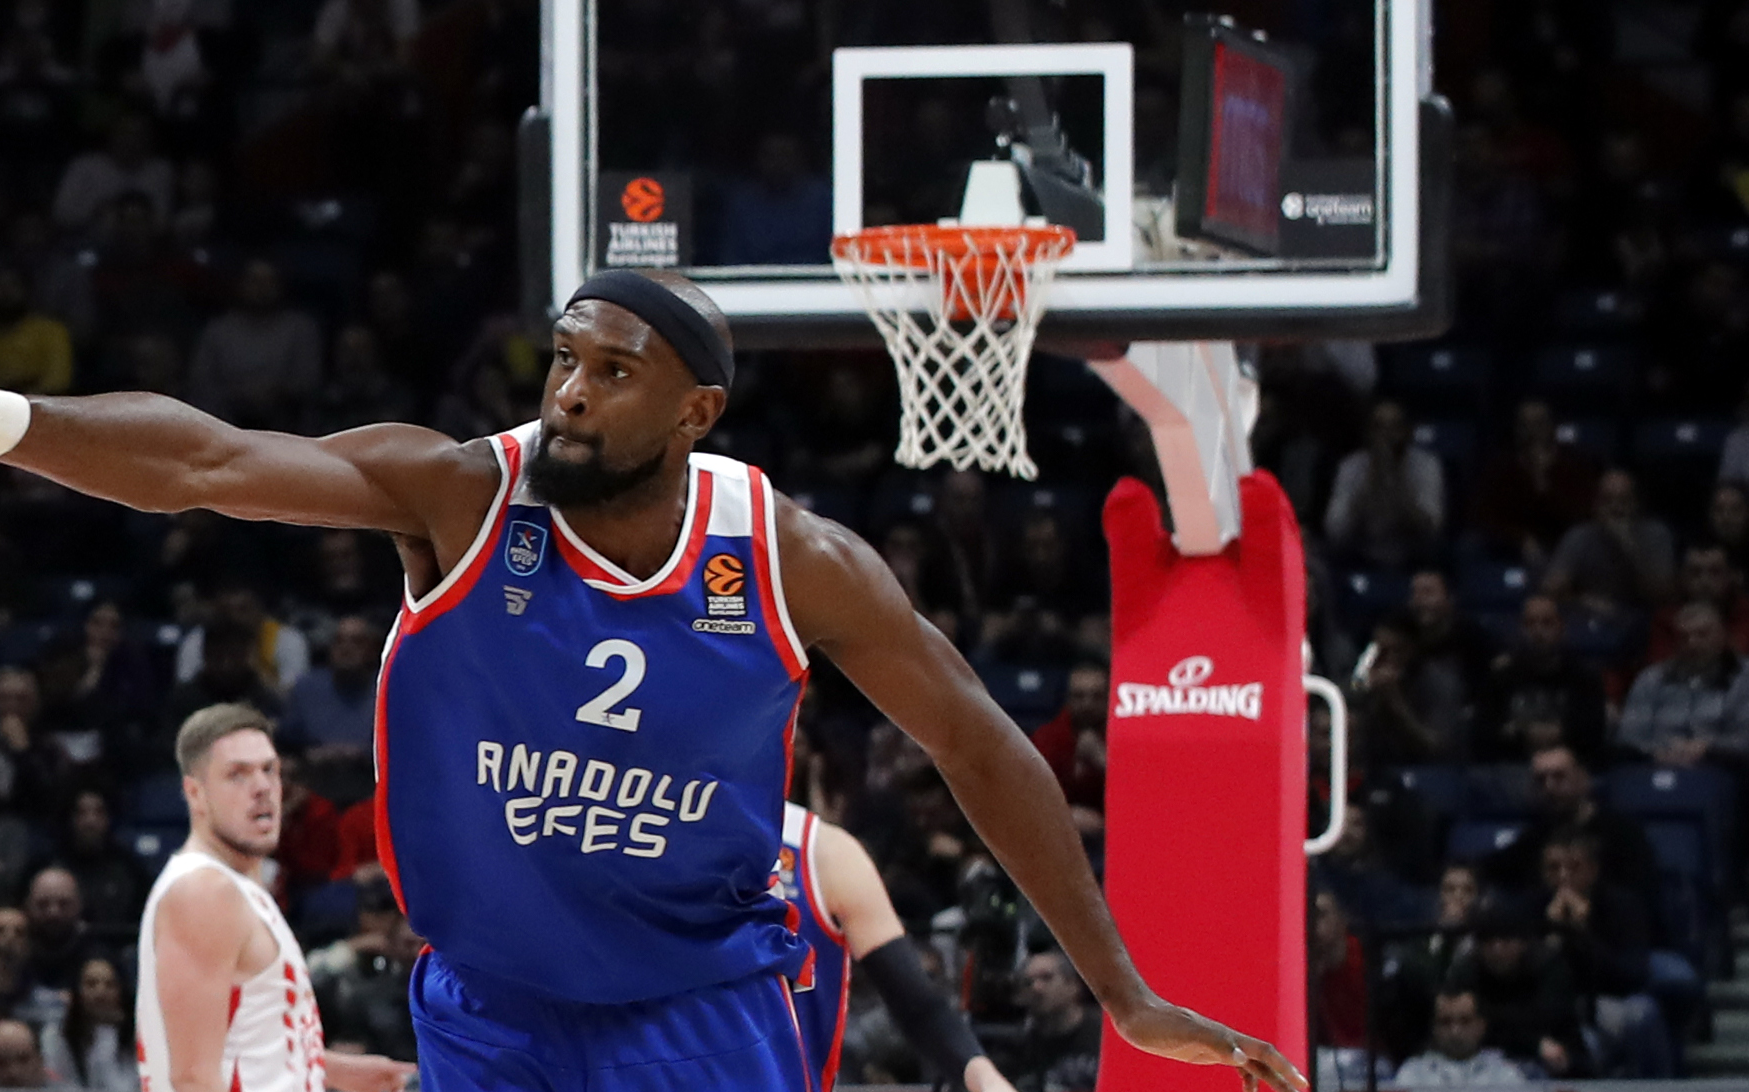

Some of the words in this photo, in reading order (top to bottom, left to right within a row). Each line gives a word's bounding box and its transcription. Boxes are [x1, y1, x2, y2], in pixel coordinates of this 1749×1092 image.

[575, 638, 647, 733] 2
[1115, 682, 1264, 721] SPALDING
[476, 740, 718, 823] ANADOLU
[505, 797, 670, 859] EFES
